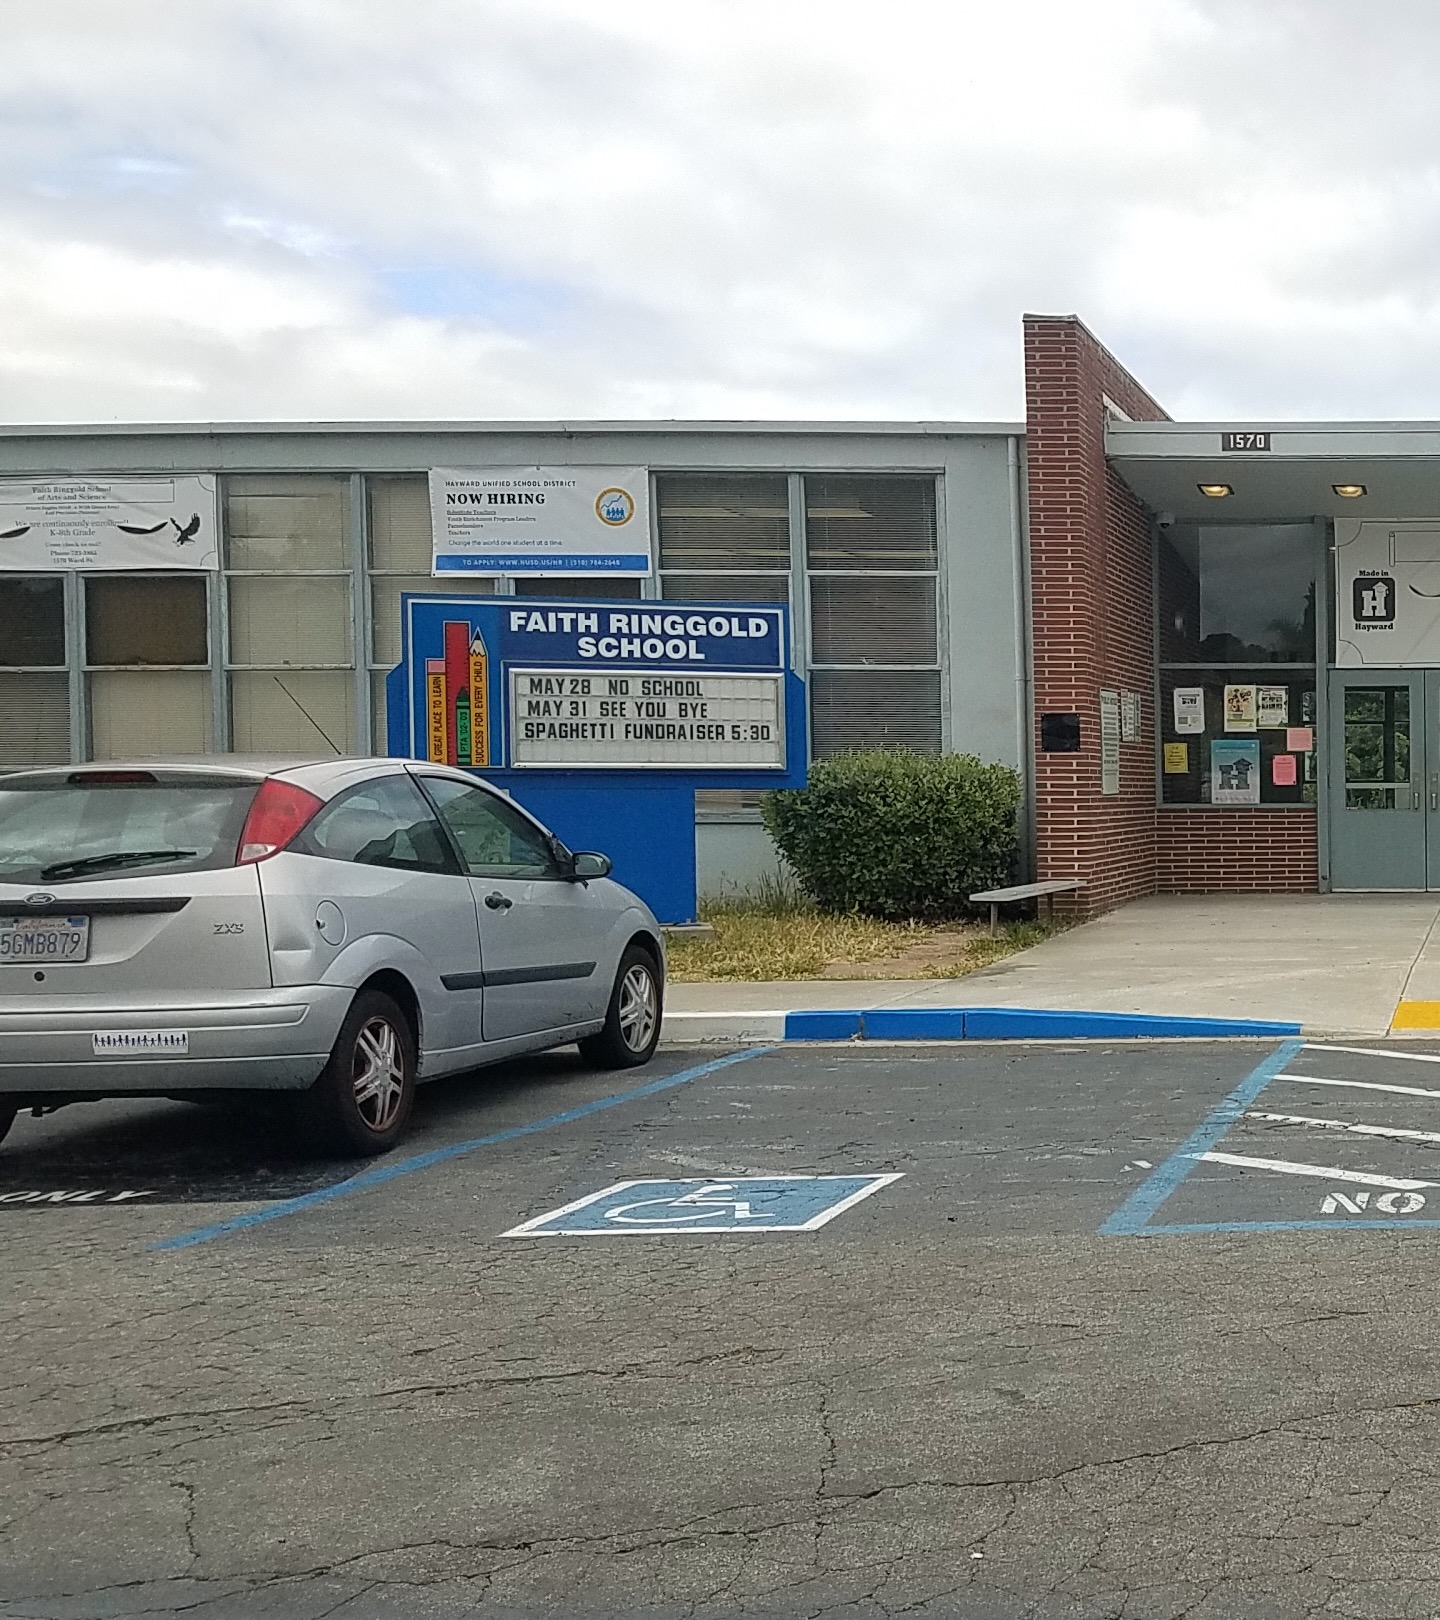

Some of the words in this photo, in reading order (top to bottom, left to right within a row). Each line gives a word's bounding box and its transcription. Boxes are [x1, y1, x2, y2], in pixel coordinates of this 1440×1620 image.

[1229, 434, 1265, 448] 1570
[446, 493, 483, 505] NOW
[487, 493, 546, 505] HIRING
[42, 520, 89, 528] continuously
[510, 611, 598, 634] FAITH
[609, 613, 769, 637] RINGGOLD
[1355, 623, 1394, 632] Hayward
[577, 637, 705, 660] SCHOOL
[473, 661, 483, 683] CHILD
[433, 677, 442, 697] LEARN
[474, 686, 483, 708] EVERY
[529, 677, 565, 695] MAY
[570, 678, 591, 695] 28
[608, 679, 629, 696] NO
[642, 680, 704, 697] SCHOOL
[433, 700, 442, 708] TO
[527, 700, 563, 717] MAY
[570, 700, 587, 717] 31
[600, 701, 626, 718] SEE
[634, 701, 666, 718] YOU
[679, 702, 708, 718] BYE
[433, 711, 442, 732] PLACE
[475, 712, 483, 727] FOR
[525, 722, 614, 739] SPAGHETTI
[624, 723, 725, 740] FUNDRAISER
[732, 725, 770, 741] 5:30
[434, 736, 443, 756] GREAT
[460, 737, 468, 752] PTA
[475, 730, 484, 763] SUCCESS
[0, 932, 81, 955] 5GMB879
[0, 1190, 160, 1202] ONLY
[1319, 1191, 1426, 1214] NO
